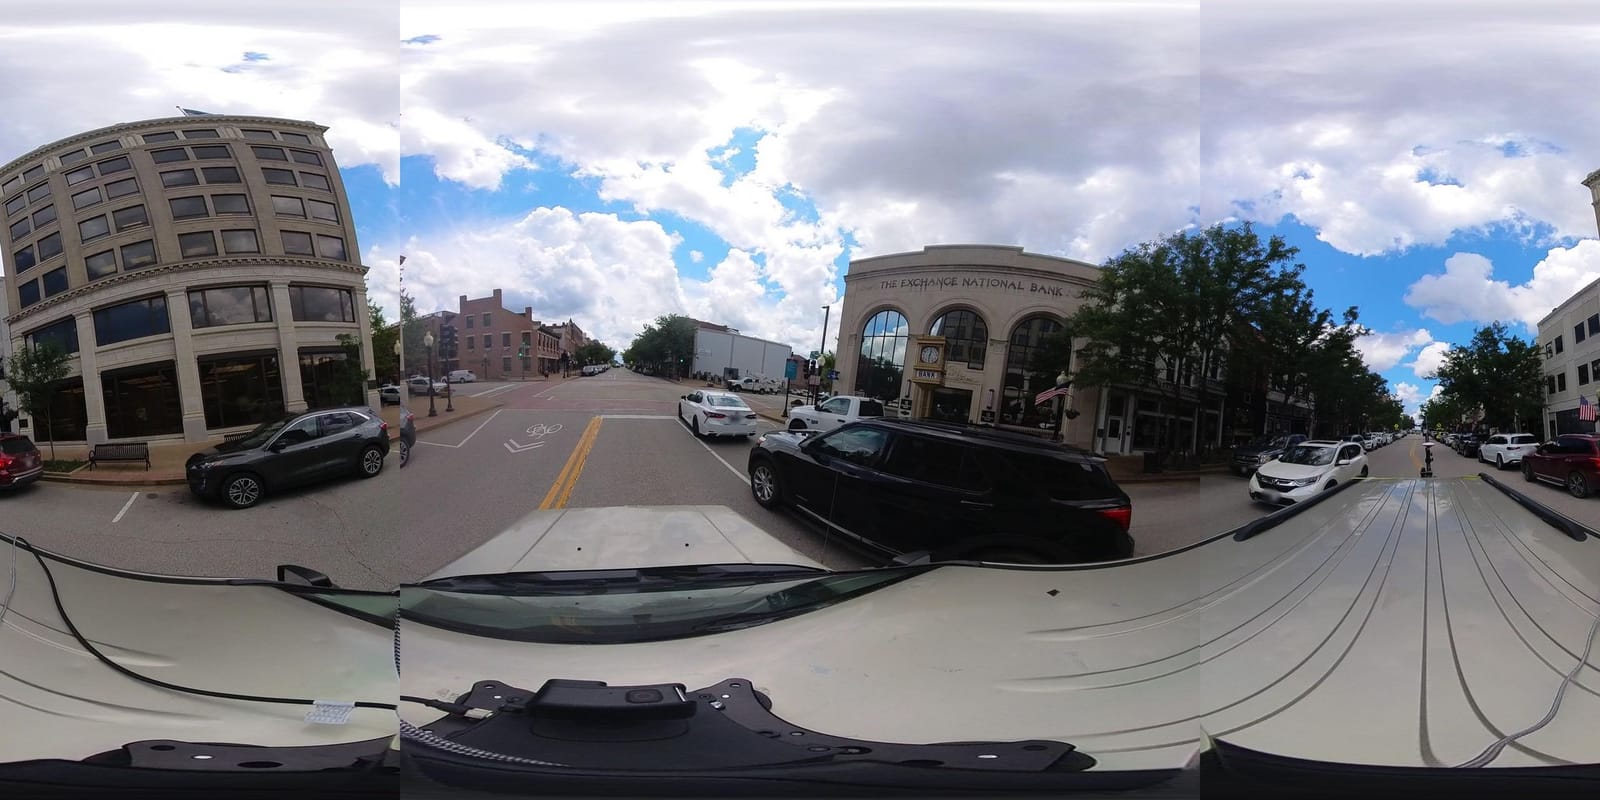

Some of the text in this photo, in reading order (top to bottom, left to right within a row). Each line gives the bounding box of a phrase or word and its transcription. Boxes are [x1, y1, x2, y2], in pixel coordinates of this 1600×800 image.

[880, 277, 1063, 296] THE EXCHANGE NATIONAL BANK
[918, 370, 936, 378] BANK
